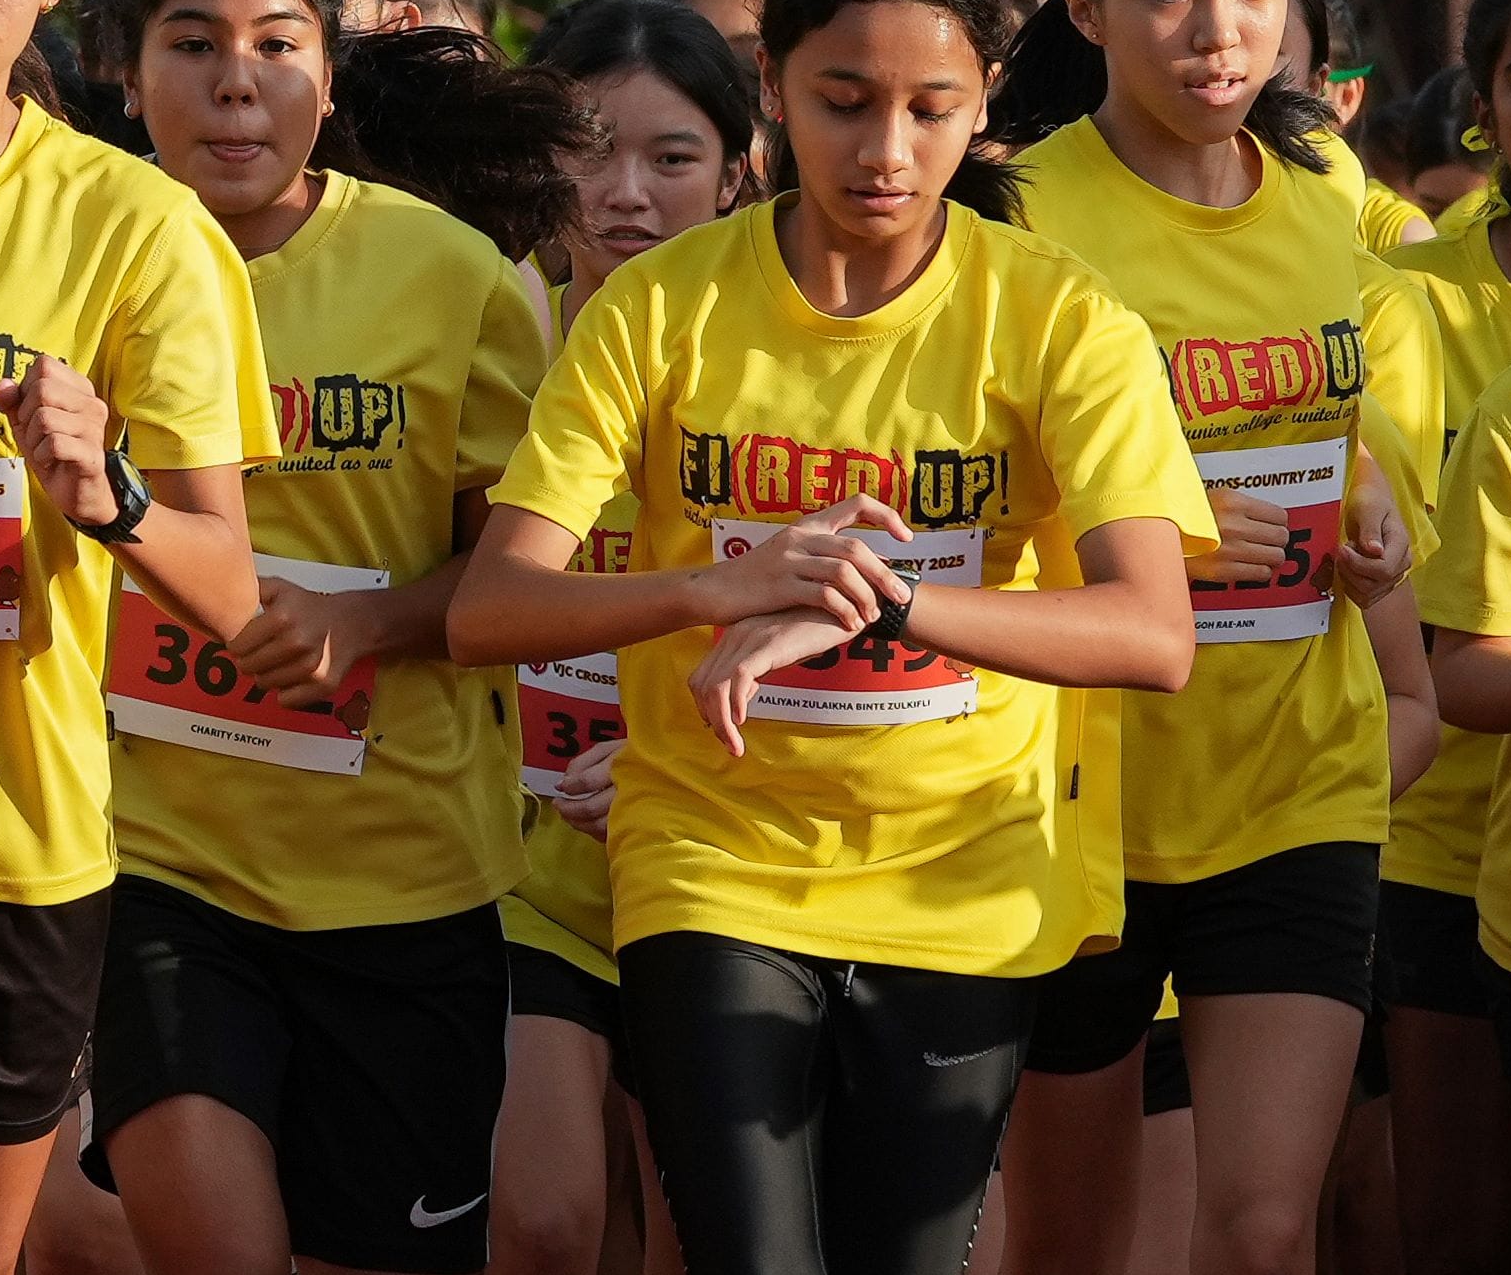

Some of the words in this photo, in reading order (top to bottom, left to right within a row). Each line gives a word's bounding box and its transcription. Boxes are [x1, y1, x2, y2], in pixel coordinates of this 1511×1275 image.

[316, 378, 406, 451] UP!
[1291, 404, 1346, 424] united
[278, 453, 336, 473] united
[340, 459, 361, 470] as
[1307, 466, 1334, 483] 2025
[928, 554, 966, 571] 2025
[146, 624, 334, 715] 36
[553, 662, 573, 678] VJC
[575, 669, 618, 686] CROSS
[757, 695, 800, 708] AALIYAH
[802, 698, 854, 711] ZULAIKHA
[855, 699, 885, 711] BINTE
[887, 699, 931, 711] ZULKIFLI
[190, 724, 233, 741] CHARITY
[234, 733, 272, 748] SATCHY
